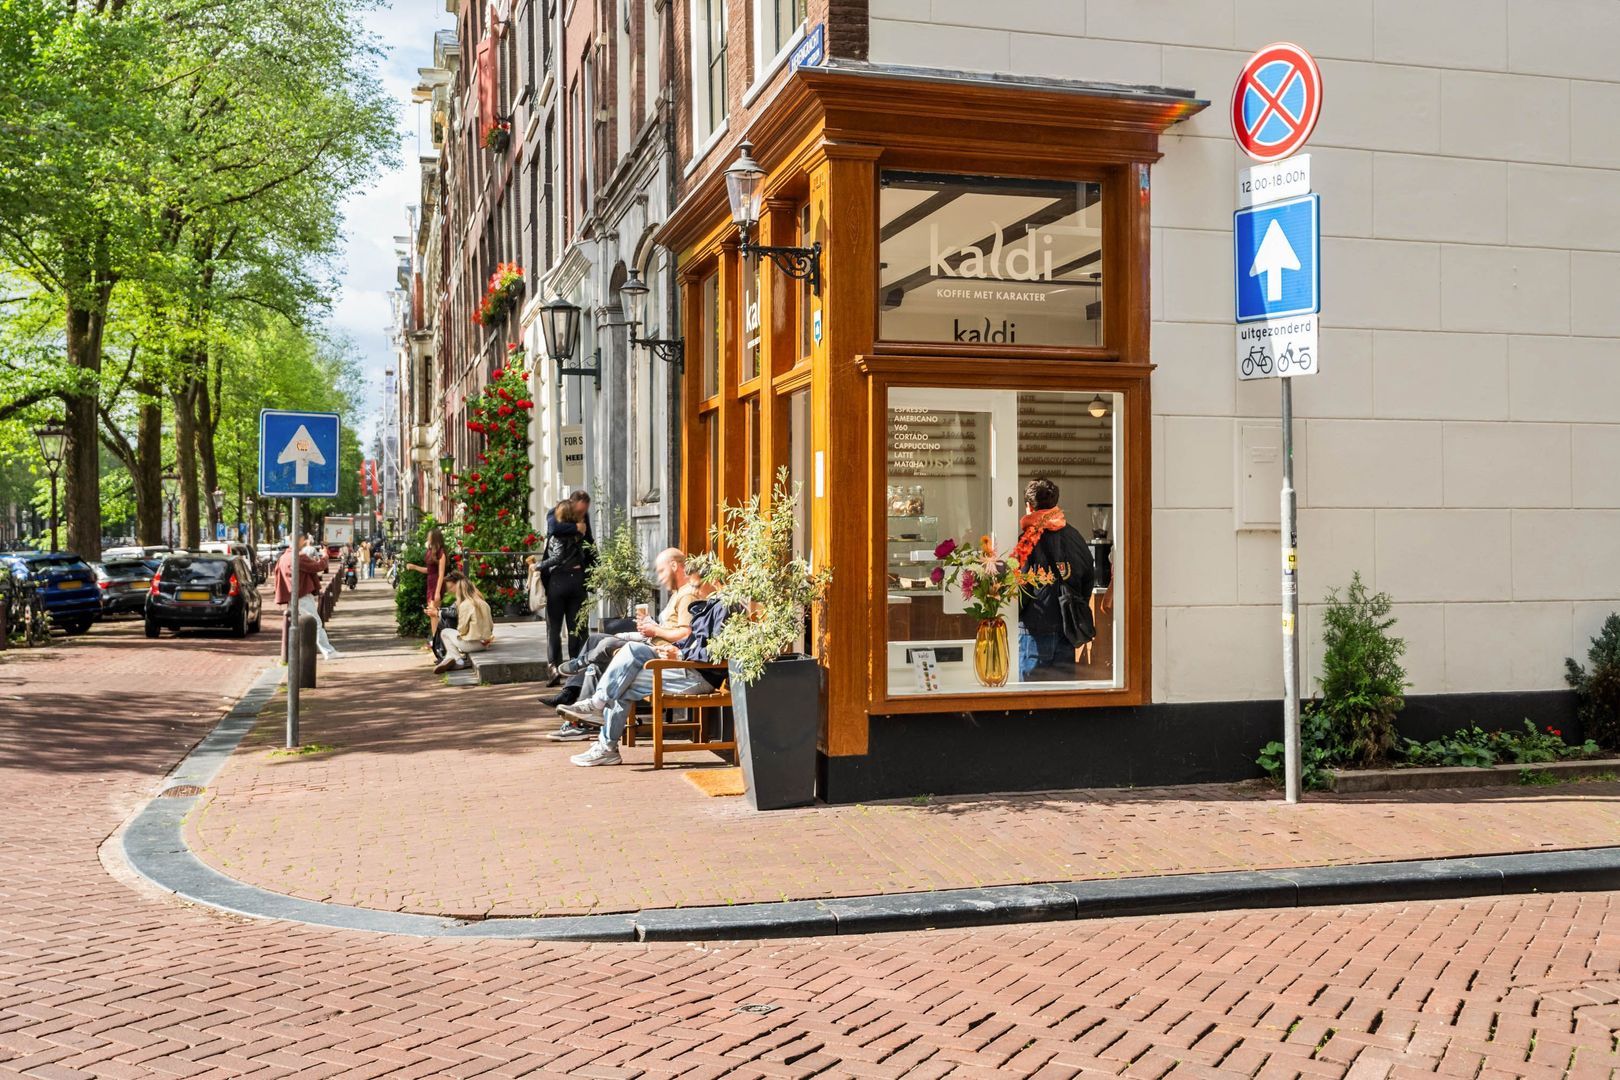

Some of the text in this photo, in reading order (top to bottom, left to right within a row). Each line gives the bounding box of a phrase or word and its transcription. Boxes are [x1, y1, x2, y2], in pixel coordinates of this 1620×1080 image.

[1241, 170, 1306, 194] 12.00-18.00h
[930, 221, 1053, 281] kaldi
[936, 288, 1046, 302] KOFFIE MET KARAKTER
[953, 317, 1016, 344] kaldi
[1241, 319, 1312, 342] uitgezonderd
[893, 406, 929, 414] ESPRESSO
[893, 415, 938, 423] AMERICANO
[564, 436, 578, 446] FOR
[893, 433, 929, 441] CORTADO
[893, 442, 941, 450] CAPPUCCINO
[893, 451, 914, 459] LATTE
[893, 460, 925, 469] MATCHA
